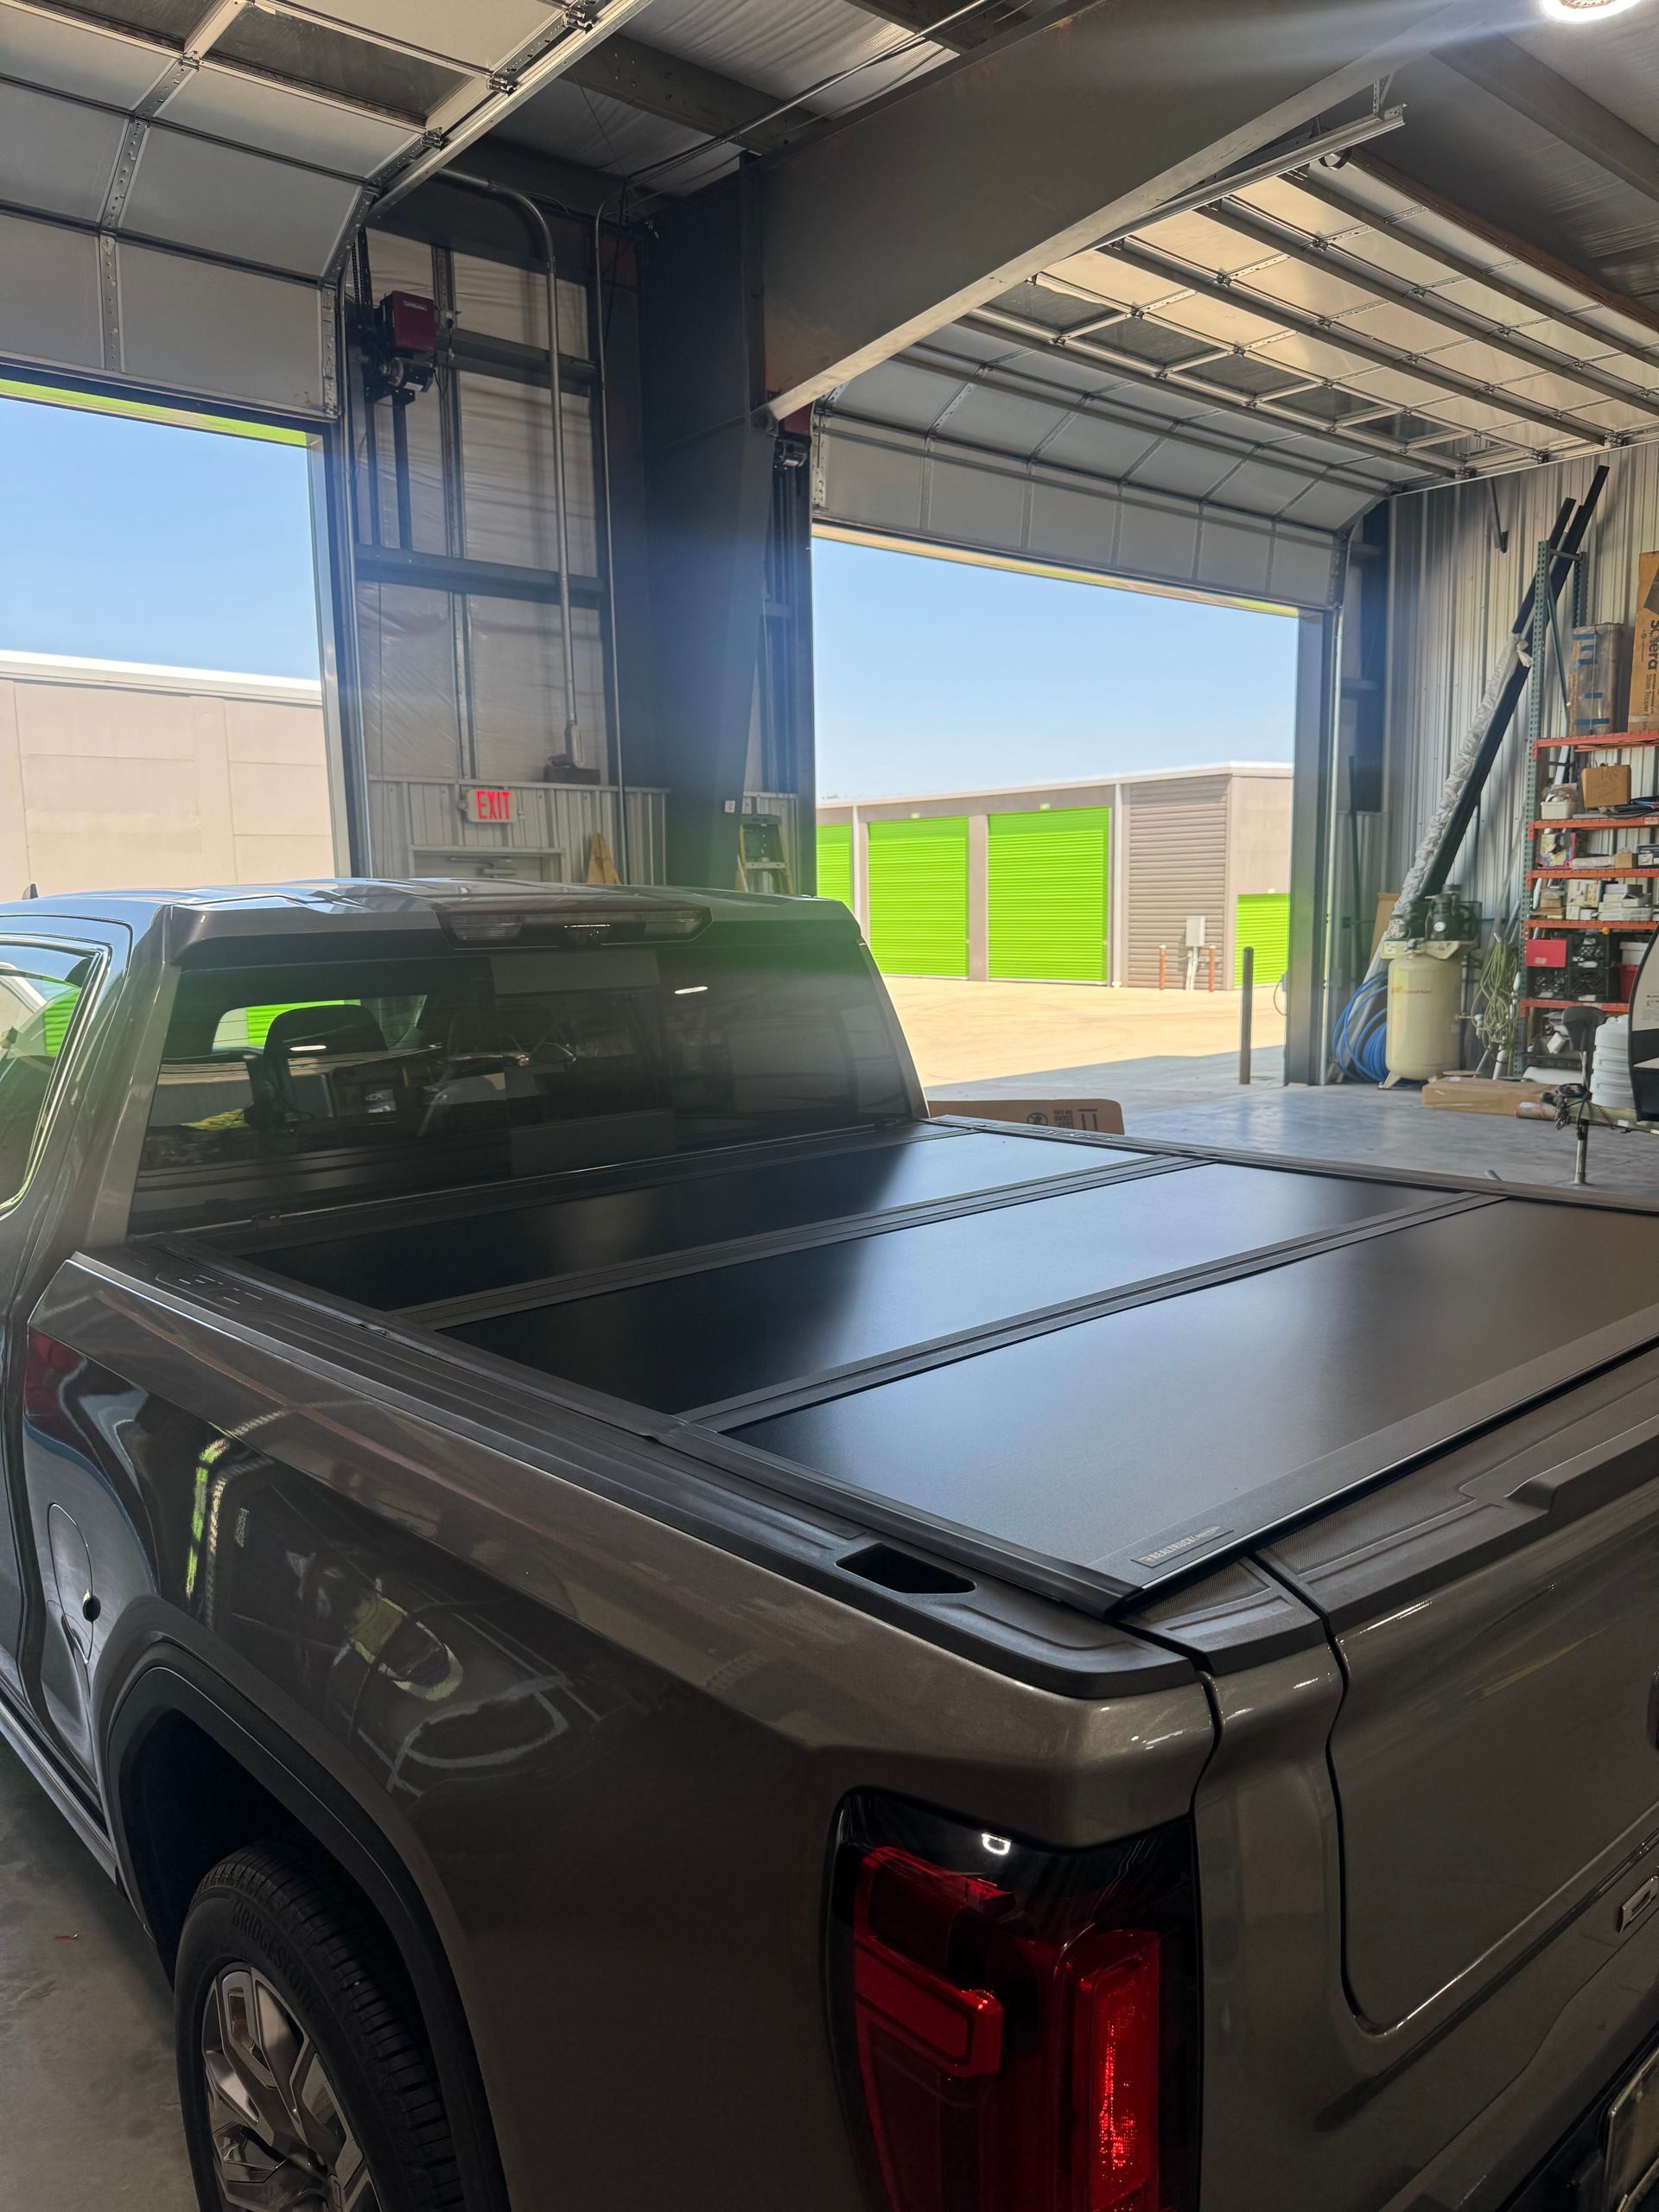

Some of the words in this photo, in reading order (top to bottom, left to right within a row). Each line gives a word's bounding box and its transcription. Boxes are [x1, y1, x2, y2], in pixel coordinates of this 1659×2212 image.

[476, 791, 511, 821] EXIT
[1148, 1535, 1195, 1560] REALTRUCK
[232, 1897, 313, 2013] BRIDGESTON
